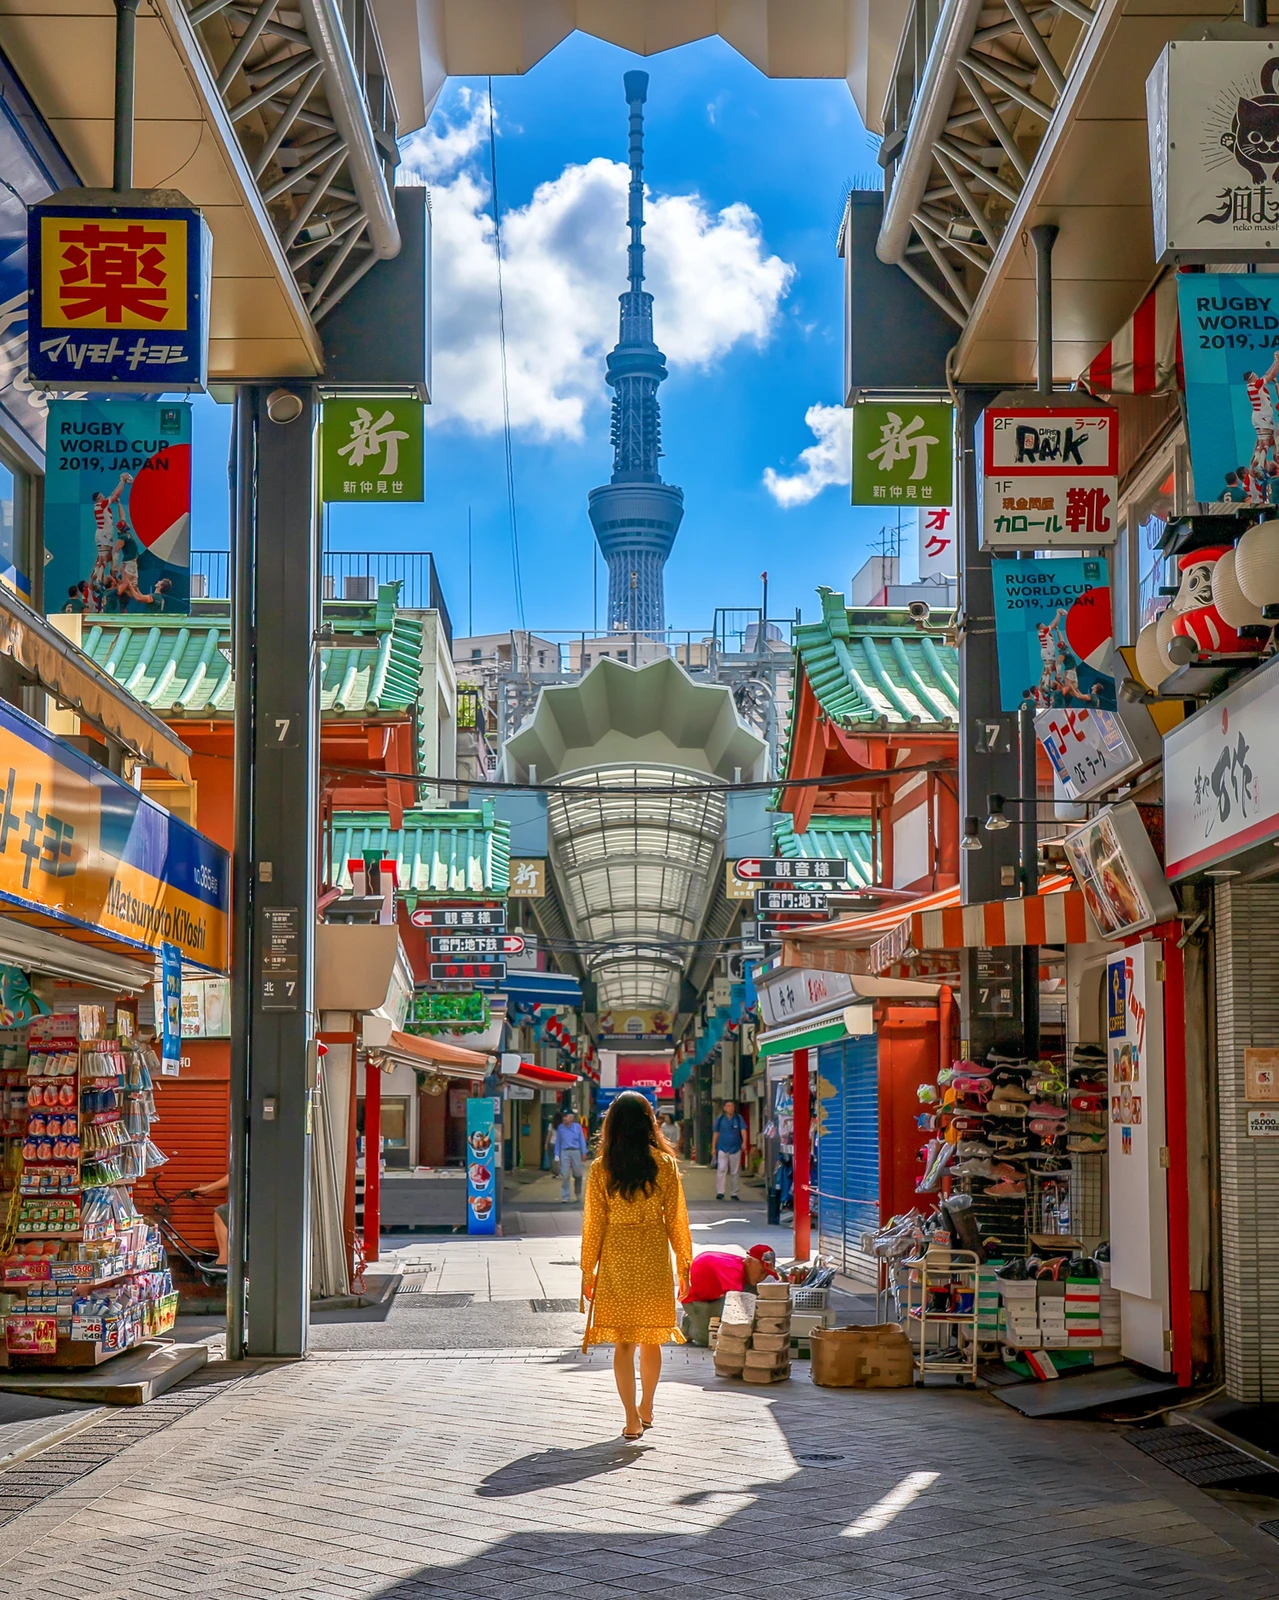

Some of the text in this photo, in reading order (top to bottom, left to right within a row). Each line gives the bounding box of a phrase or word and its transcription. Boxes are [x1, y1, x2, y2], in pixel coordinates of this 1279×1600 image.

[1233, 222, 1252, 231] neko
[59, 224, 169, 323] 薬
[1196, 297, 1272, 311] RUGBY
[1197, 315, 1279, 330] WORLD
[1199, 333, 1254, 351] 2019,
[40, 335, 188, 370] マツモトキヨシ
[61, 422, 124, 435] RUGBY
[994, 418, 1107, 431] 2F ラーク
[60, 440, 169, 453] WORLD CUP
[337, 407, 410, 475] 新
[867, 411, 940, 480] 新
[59, 458, 169, 472] 2019, JAPAN
[343, 481, 404, 494] 新仲見世
[873, 485, 933, 499] 新仲見世
[995, 481, 1013, 493] 1F
[1002, 497, 1055, 511] 現金問屋
[1065, 488, 1111, 532] 靴
[993, 515, 1063, 533] カロール
[925, 508, 951, 557] オケ
[1005, 574, 1055, 584] RUGBY
[1006, 584, 1093, 596] WORLD CUP
[1007, 597, 1094, 610] 2019, JAPAN
[276, 719, 290, 741] 7
[985, 725, 1000, 746] 7
[513, 862, 540, 888] 新
[775, 861, 830, 877] 観音様
[107, 876, 207, 951] Matsumoto KiYoshi
[444, 911, 491, 924] 観音様
[446, 965, 492, 977] 仲見世
[264, 981, 296, 996] 北 7
[979, 988, 990, 1003] 7
[1110, 1015, 1125, 1032] COFFEE
